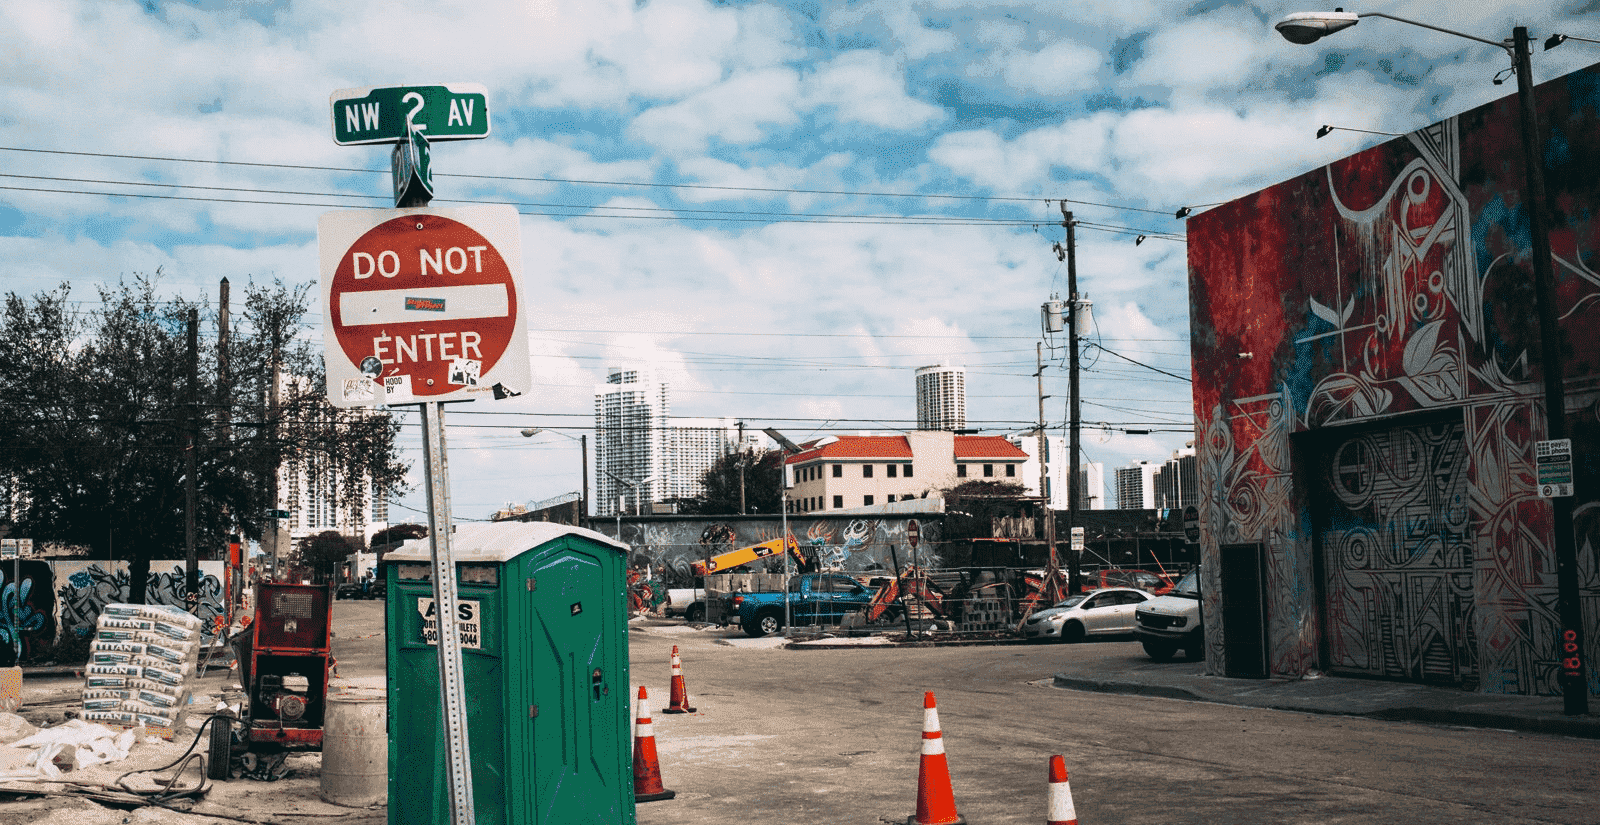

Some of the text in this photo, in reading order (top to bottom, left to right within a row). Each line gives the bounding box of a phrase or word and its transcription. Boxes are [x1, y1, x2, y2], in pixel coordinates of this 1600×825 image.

[345, 91, 475, 133] NW 2 AV
[352, 245, 488, 280] DO NOT
[373, 331, 484, 365] ENTER
[385, 376, 403, 386] HOOD
[386, 385, 395, 394] BY
[103, 619, 141, 629] TITAN
[95, 642, 133, 652] TITAN
[1563, 629, 1581, 676] 18.00
[90, 665, 128, 675] TITAN
[83, 690, 121, 700] TITAN
[84, 711, 122, 721] TITAN
